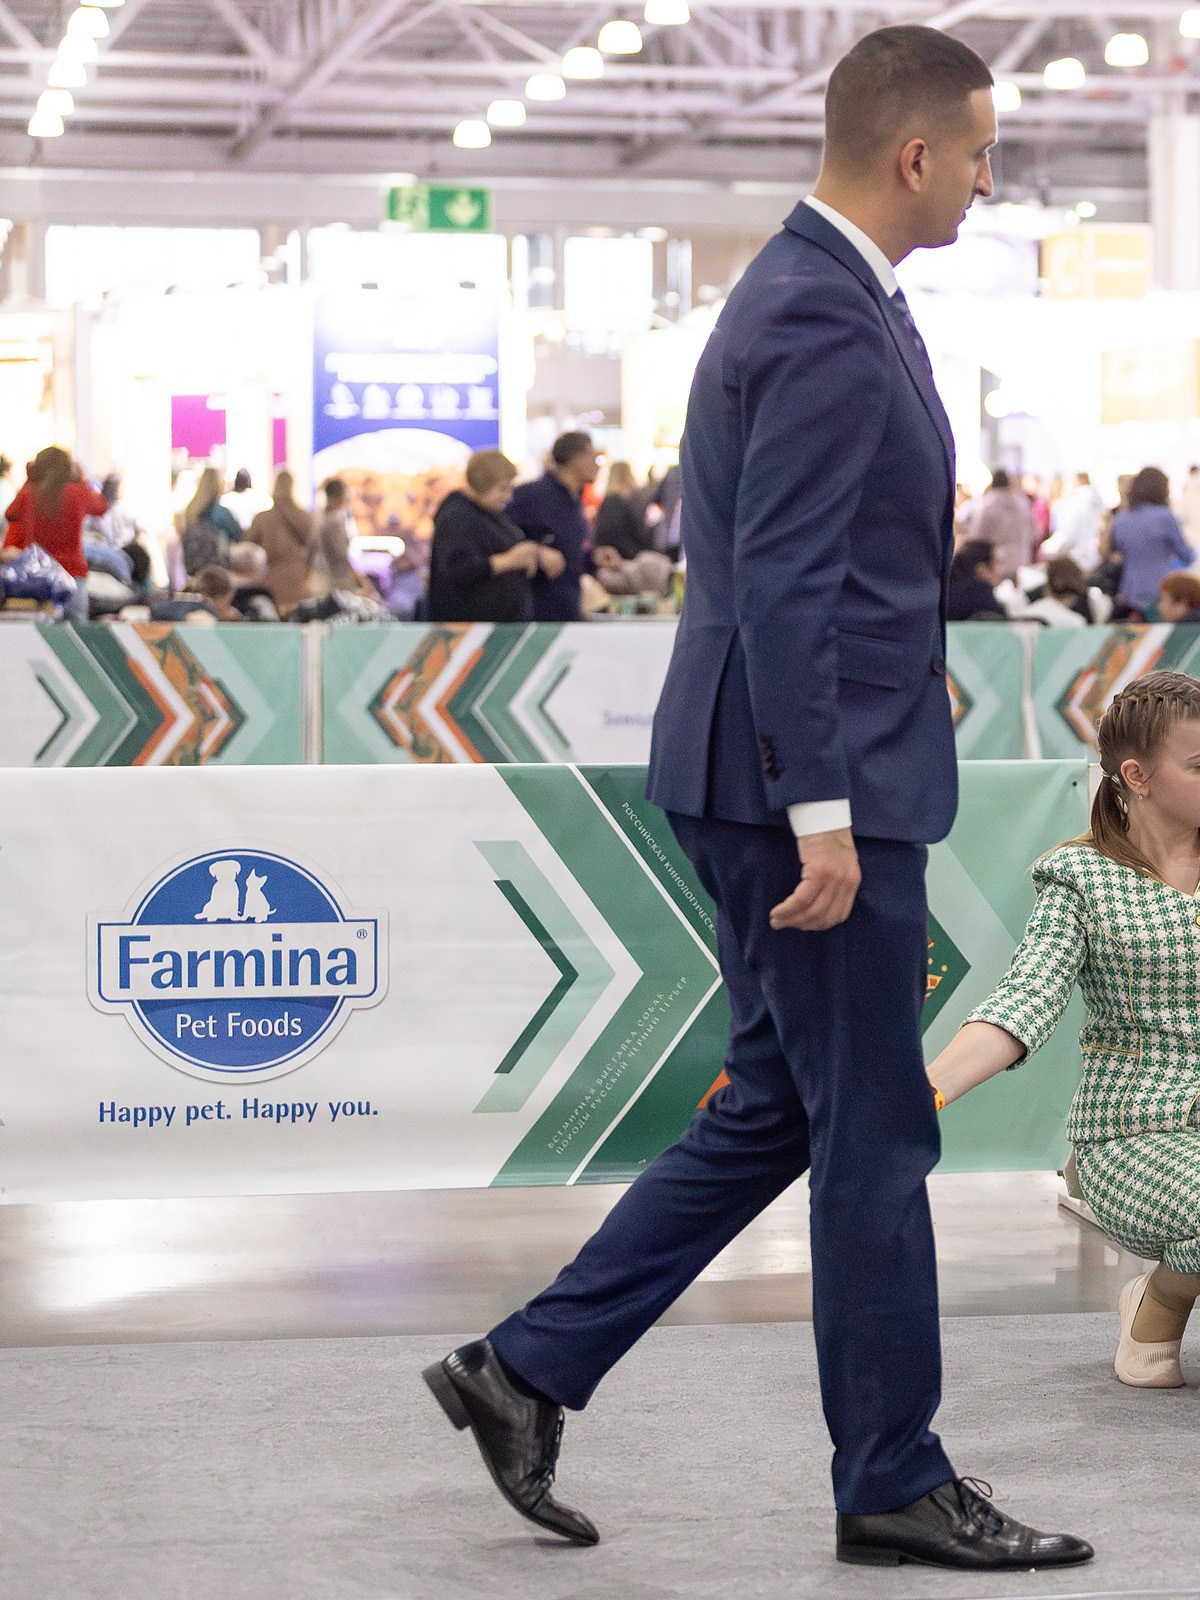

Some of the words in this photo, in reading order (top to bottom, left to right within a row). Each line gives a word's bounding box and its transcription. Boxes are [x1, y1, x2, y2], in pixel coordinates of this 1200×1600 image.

[621, 802, 667, 862] РОССИЙСКАЯ
[664, 861, 717, 936] КИНОЛОГИЧЕСК
[118, 933, 358, 989] Farmina
[176, 1013, 218, 1038] Pet
[227, 1012, 303, 1037] Foods
[99, 1101, 176, 1127] Happy
[186, 1100, 232, 1126] pet.
[242, 1098, 318, 1123] Happy
[329, 1101, 379, 1122] you.
